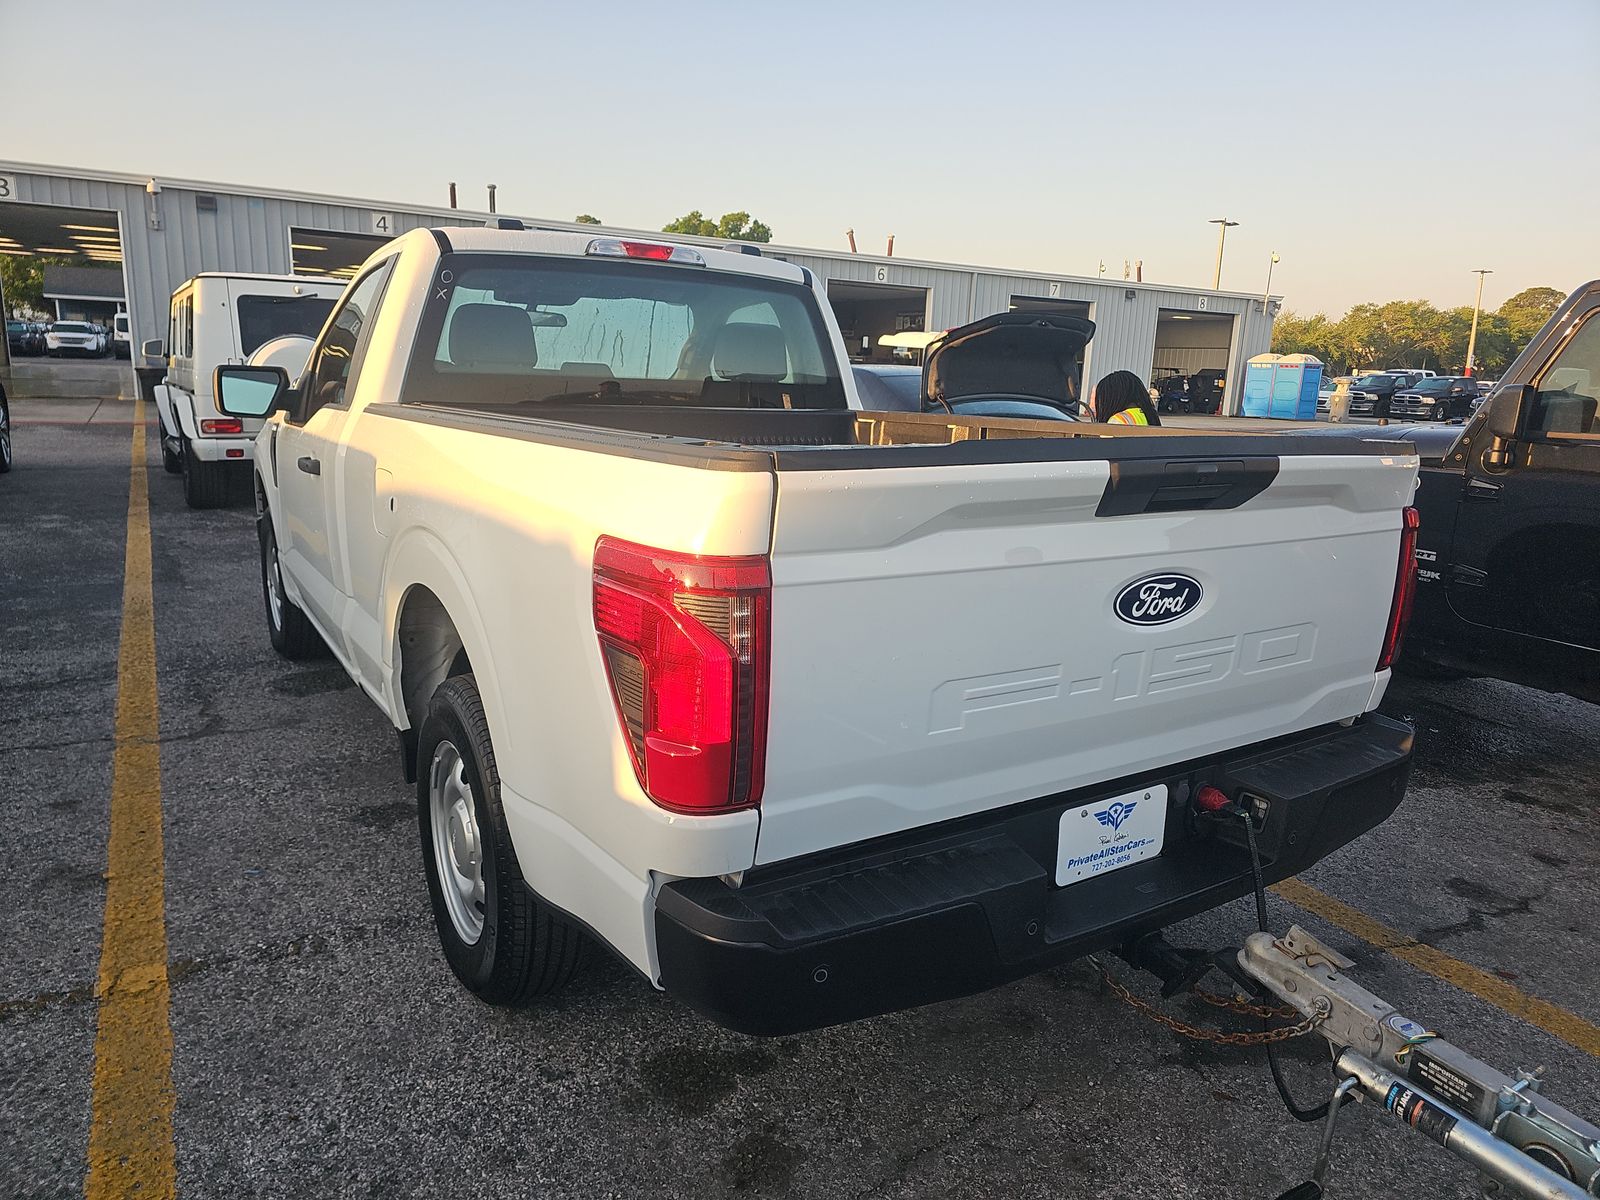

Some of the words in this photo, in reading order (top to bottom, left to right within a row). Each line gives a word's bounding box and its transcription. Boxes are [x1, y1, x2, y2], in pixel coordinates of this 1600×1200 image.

[376, 216, 389, 233] 4
[877, 268, 885, 281] 6
[1052, 284, 1058, 296] 7
[1199, 298, 1206, 309] 8
[1131, 581, 1188, 617] Ford
[927, 621, 1319, 735] F-150
[1091, 853, 1131, 872] 727-202-8056
[1428, 1061, 1470, 1088] IMPORTANT
[1399, 1089, 1413, 1107] JACK
